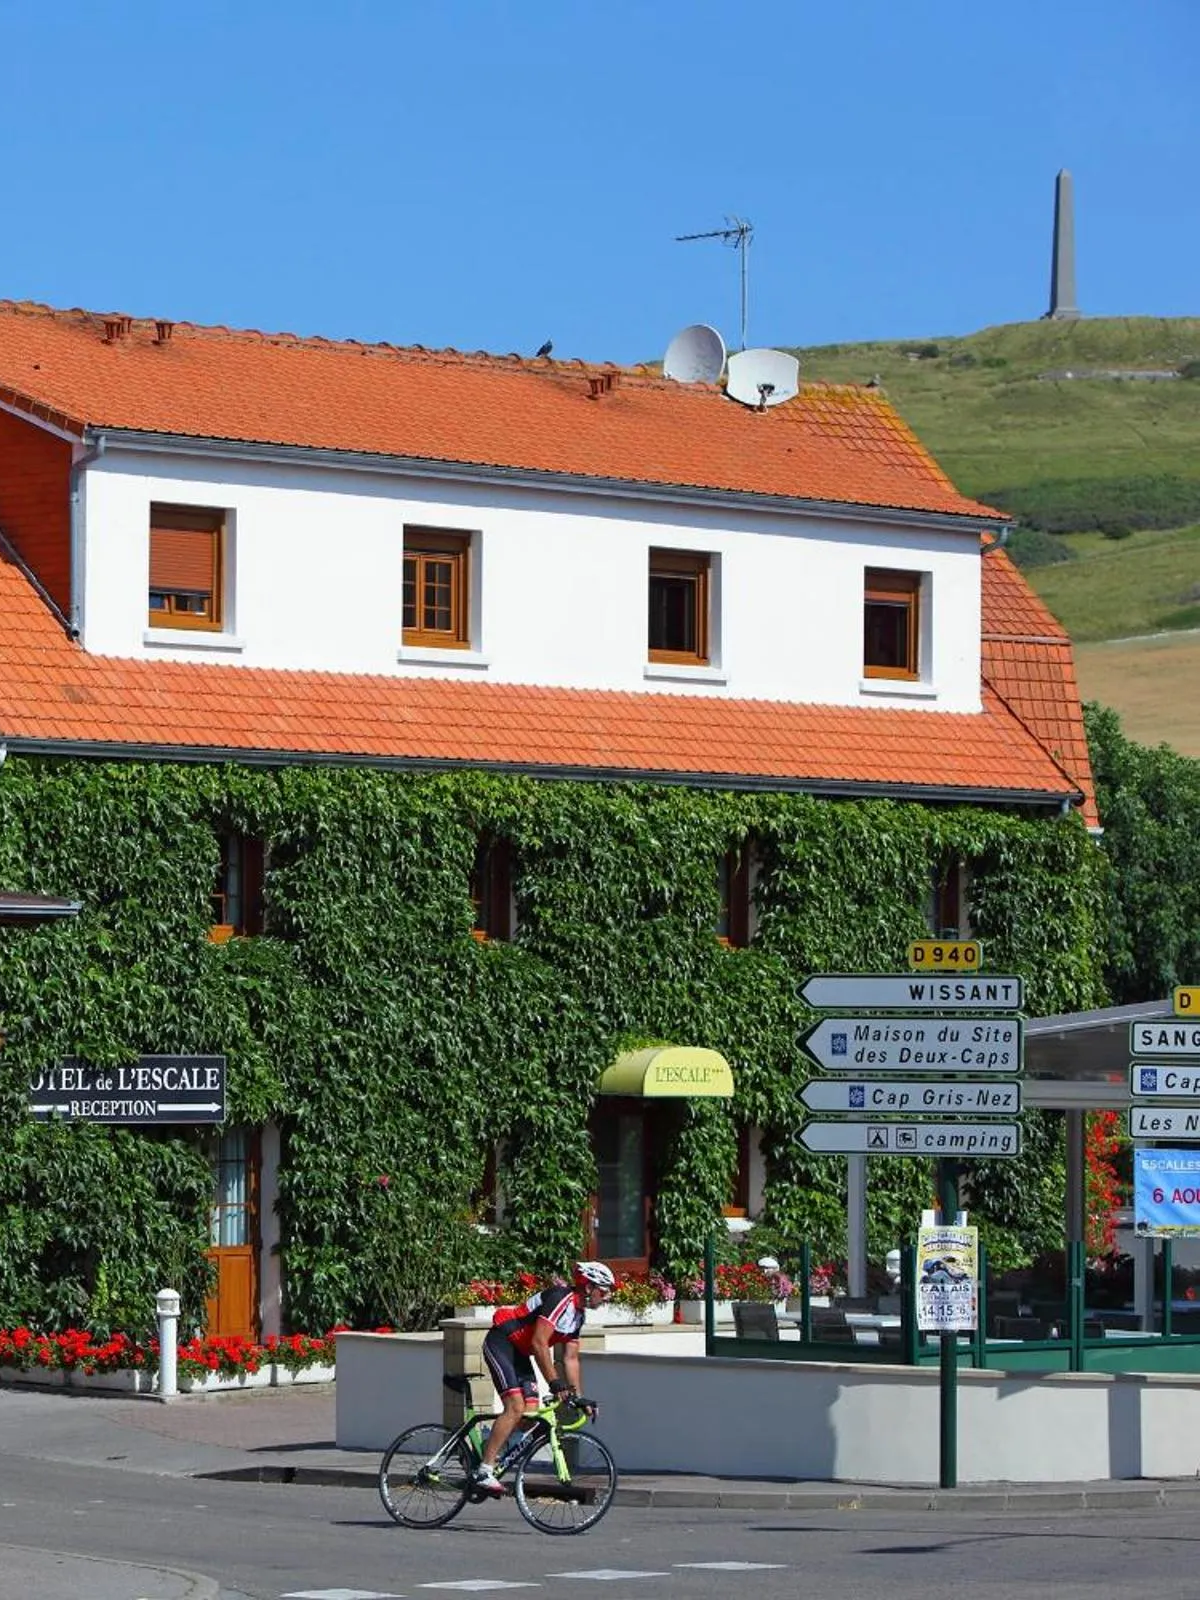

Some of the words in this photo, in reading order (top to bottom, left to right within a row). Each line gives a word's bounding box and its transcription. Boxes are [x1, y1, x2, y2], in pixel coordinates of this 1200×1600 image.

[914, 947, 924, 962] D
[933, 947, 976, 963] 940
[909, 985, 1012, 1000] WISSANT
[1180, 992, 1191, 1009] D
[854, 1025, 925, 1042] Maison
[937, 1027, 960, 1042] du
[972, 1027, 1012, 1043] Site
[1142, 1030, 1200, 1047] SANG
[855, 1048, 887, 1063] des
[899, 1047, 1010, 1068] Deux-Caps
[29, 1068, 91, 1091] OTEL
[96, 1071, 113, 1091] de
[118, 1067, 220, 1091] L'ESCALE
[656, 1067, 711, 1082] L'ESCALE
[1165, 1073, 1200, 1093] Cap
[872, 1089, 910, 1108] Cap
[923, 1089, 1012, 1106] Gris-Nez
[70, 1100, 157, 1116] RECEPTION
[1139, 1115, 1172, 1130] Les
[924, 1131, 1012, 1152] camping
[1152, 1188, 1164, 1204] 6
